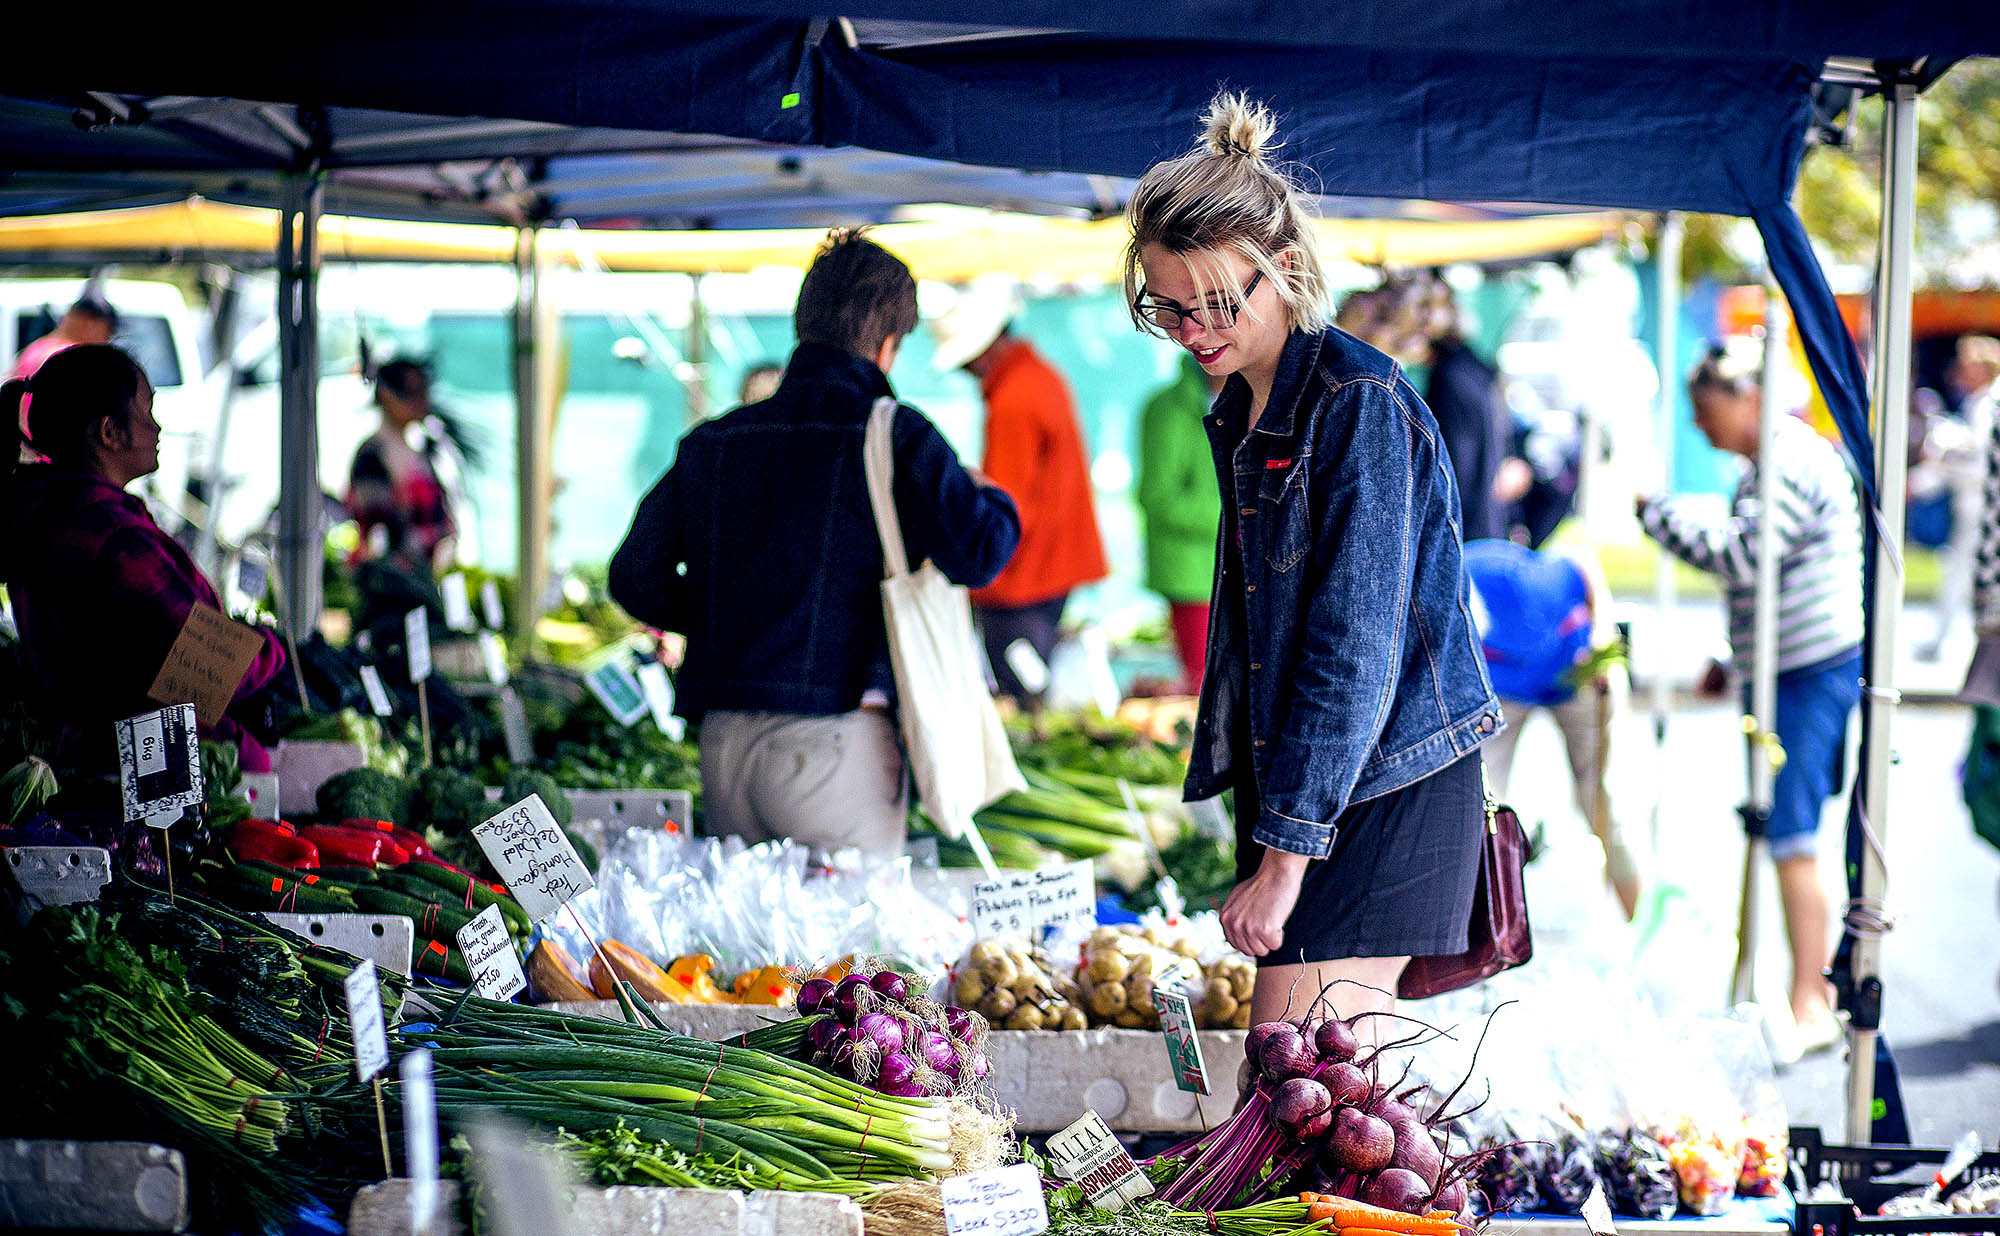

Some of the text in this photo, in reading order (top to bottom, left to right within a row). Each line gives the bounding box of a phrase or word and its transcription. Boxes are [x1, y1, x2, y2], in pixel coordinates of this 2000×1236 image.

[141, 736, 155, 761] 6kg
[502, 827, 560, 864] Red Salad
[539, 874, 581, 898] Fresh
[469, 916, 488, 933] Fresh
[467, 953, 482, 969] Red
[494, 974, 521, 1001] a bunch
[1072, 1144, 1123, 1179] PREMIUM QUALITY
[1077, 1144, 1105, 1164] PRODUCE
